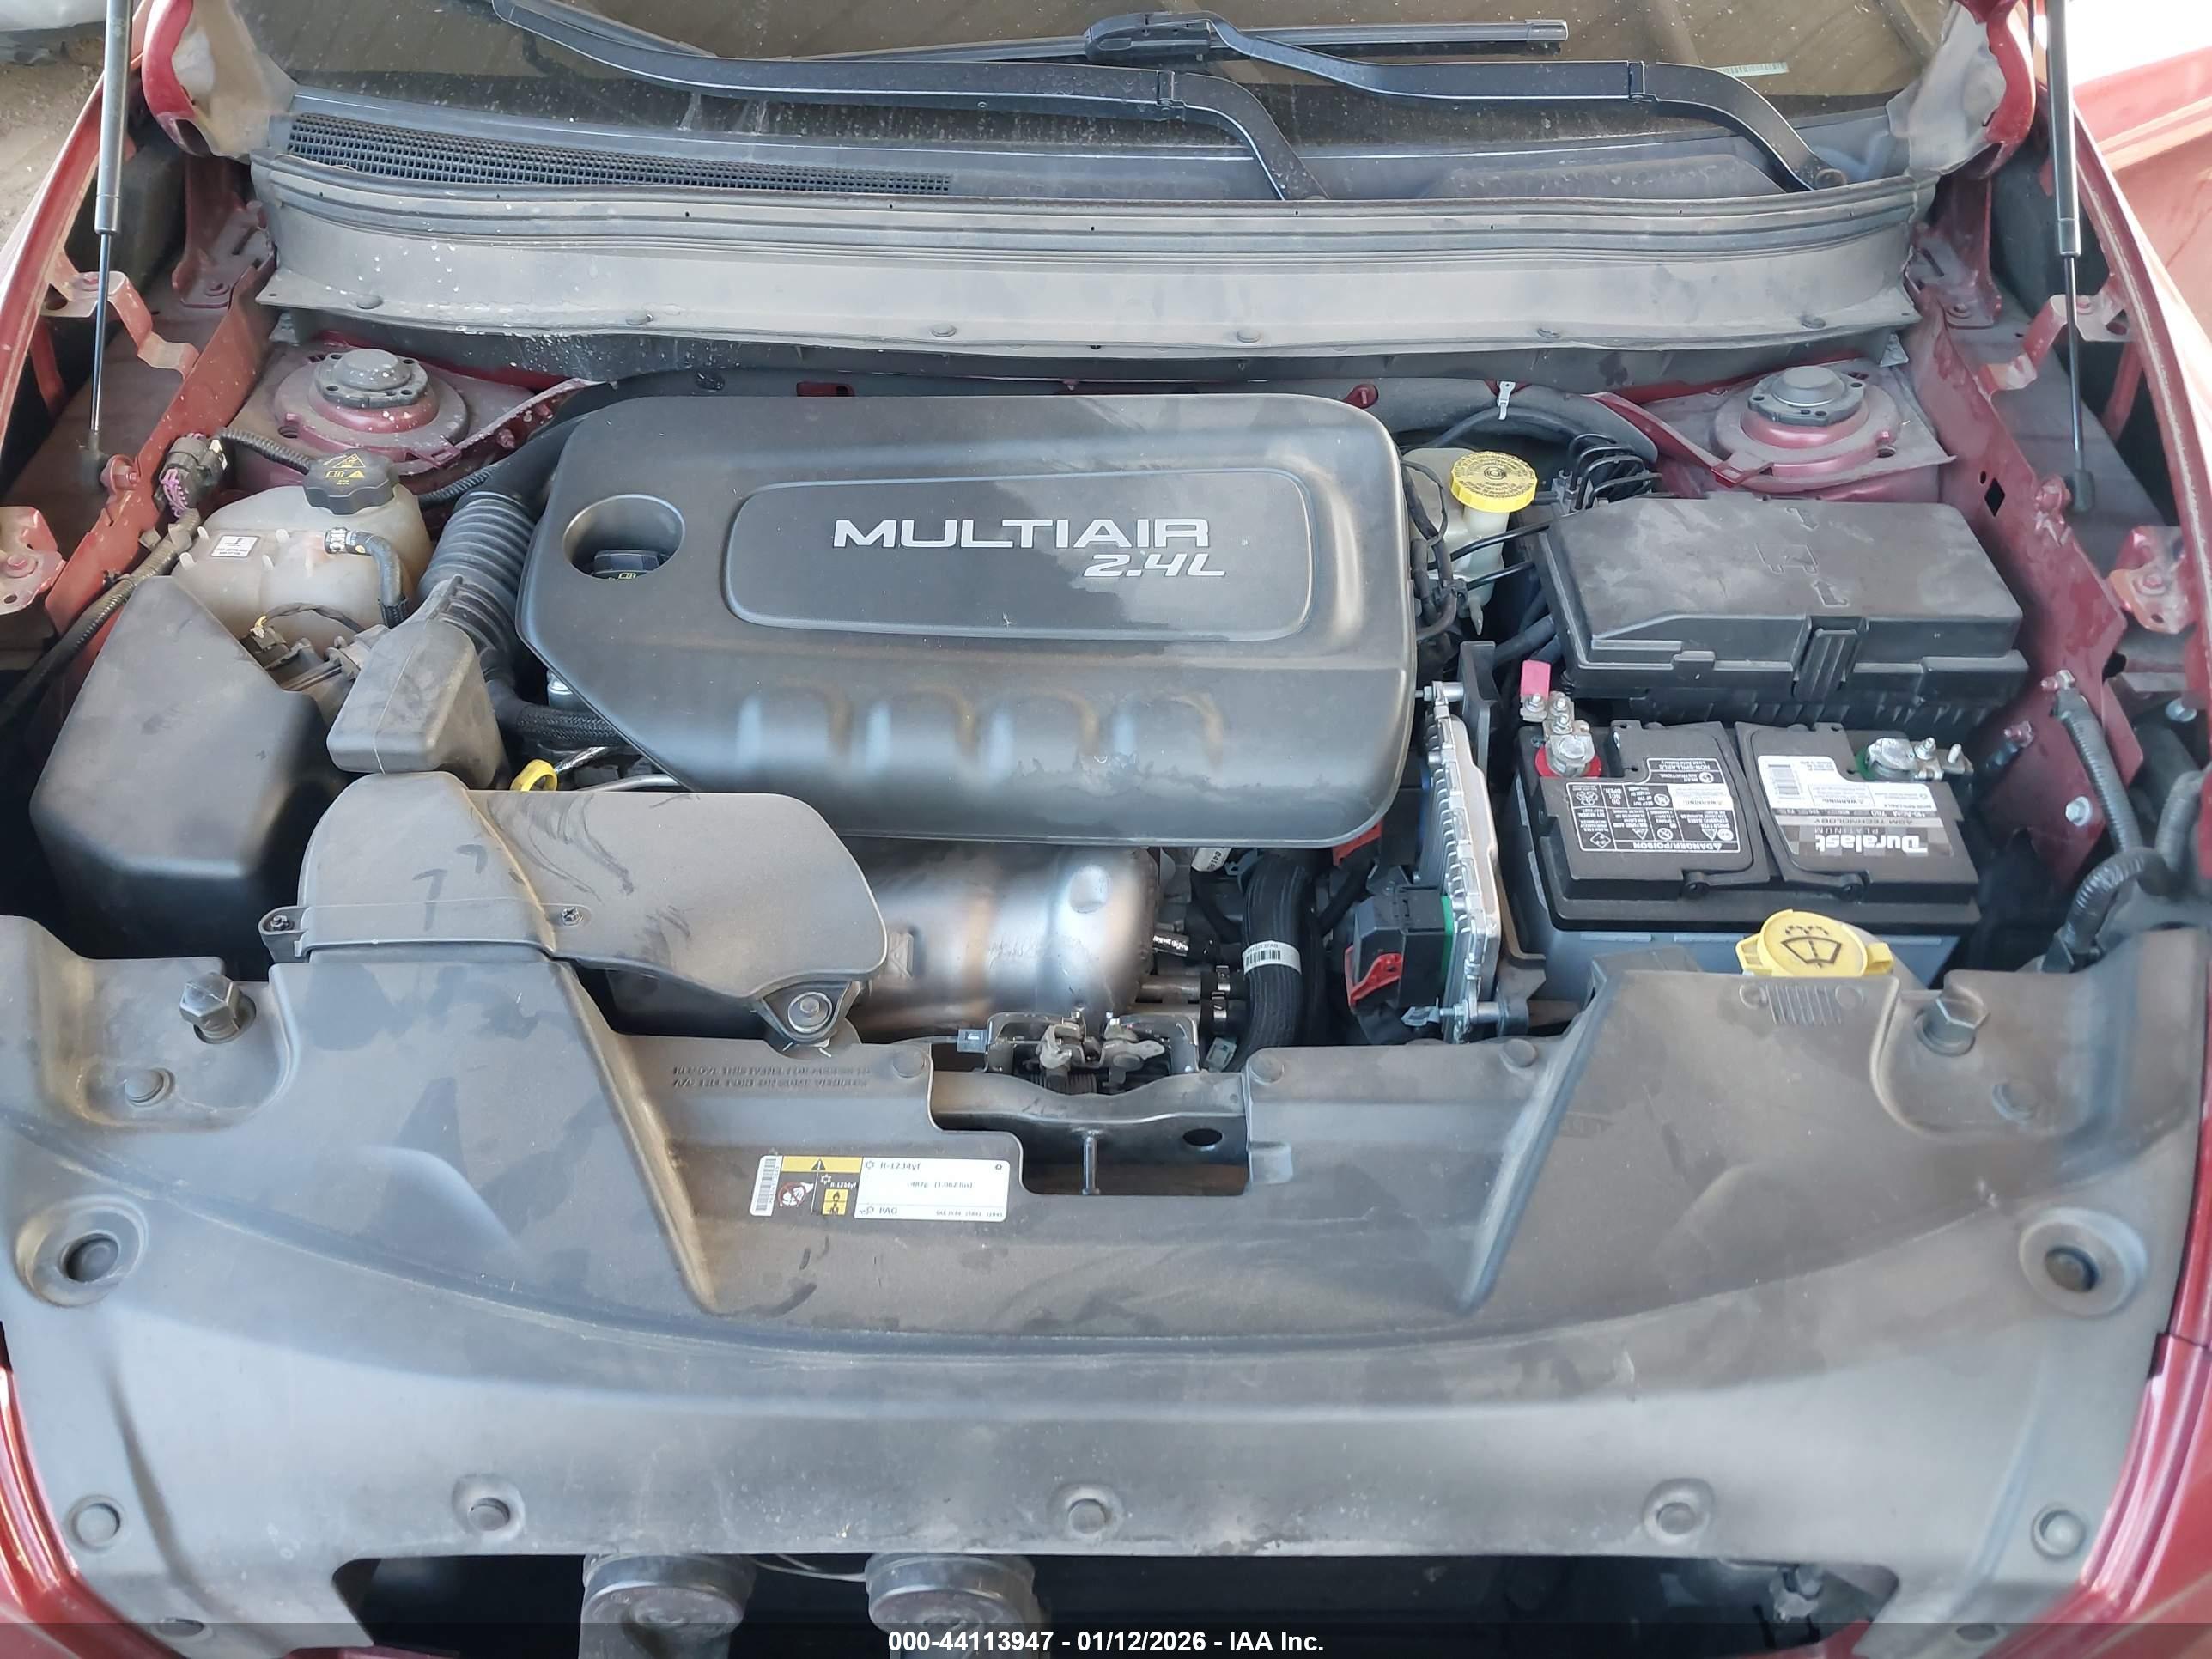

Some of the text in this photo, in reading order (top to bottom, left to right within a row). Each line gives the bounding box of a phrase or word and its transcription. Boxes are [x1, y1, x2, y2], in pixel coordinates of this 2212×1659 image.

[833, 519, 1210, 548] MULTIAIR
[1083, 553, 1225, 577] 2.4L
[1814, 835, 1929, 853] Duralast
[880, 1162, 921, 1170] R-1234yf
[879, 1206, 898, 1215] PAG
